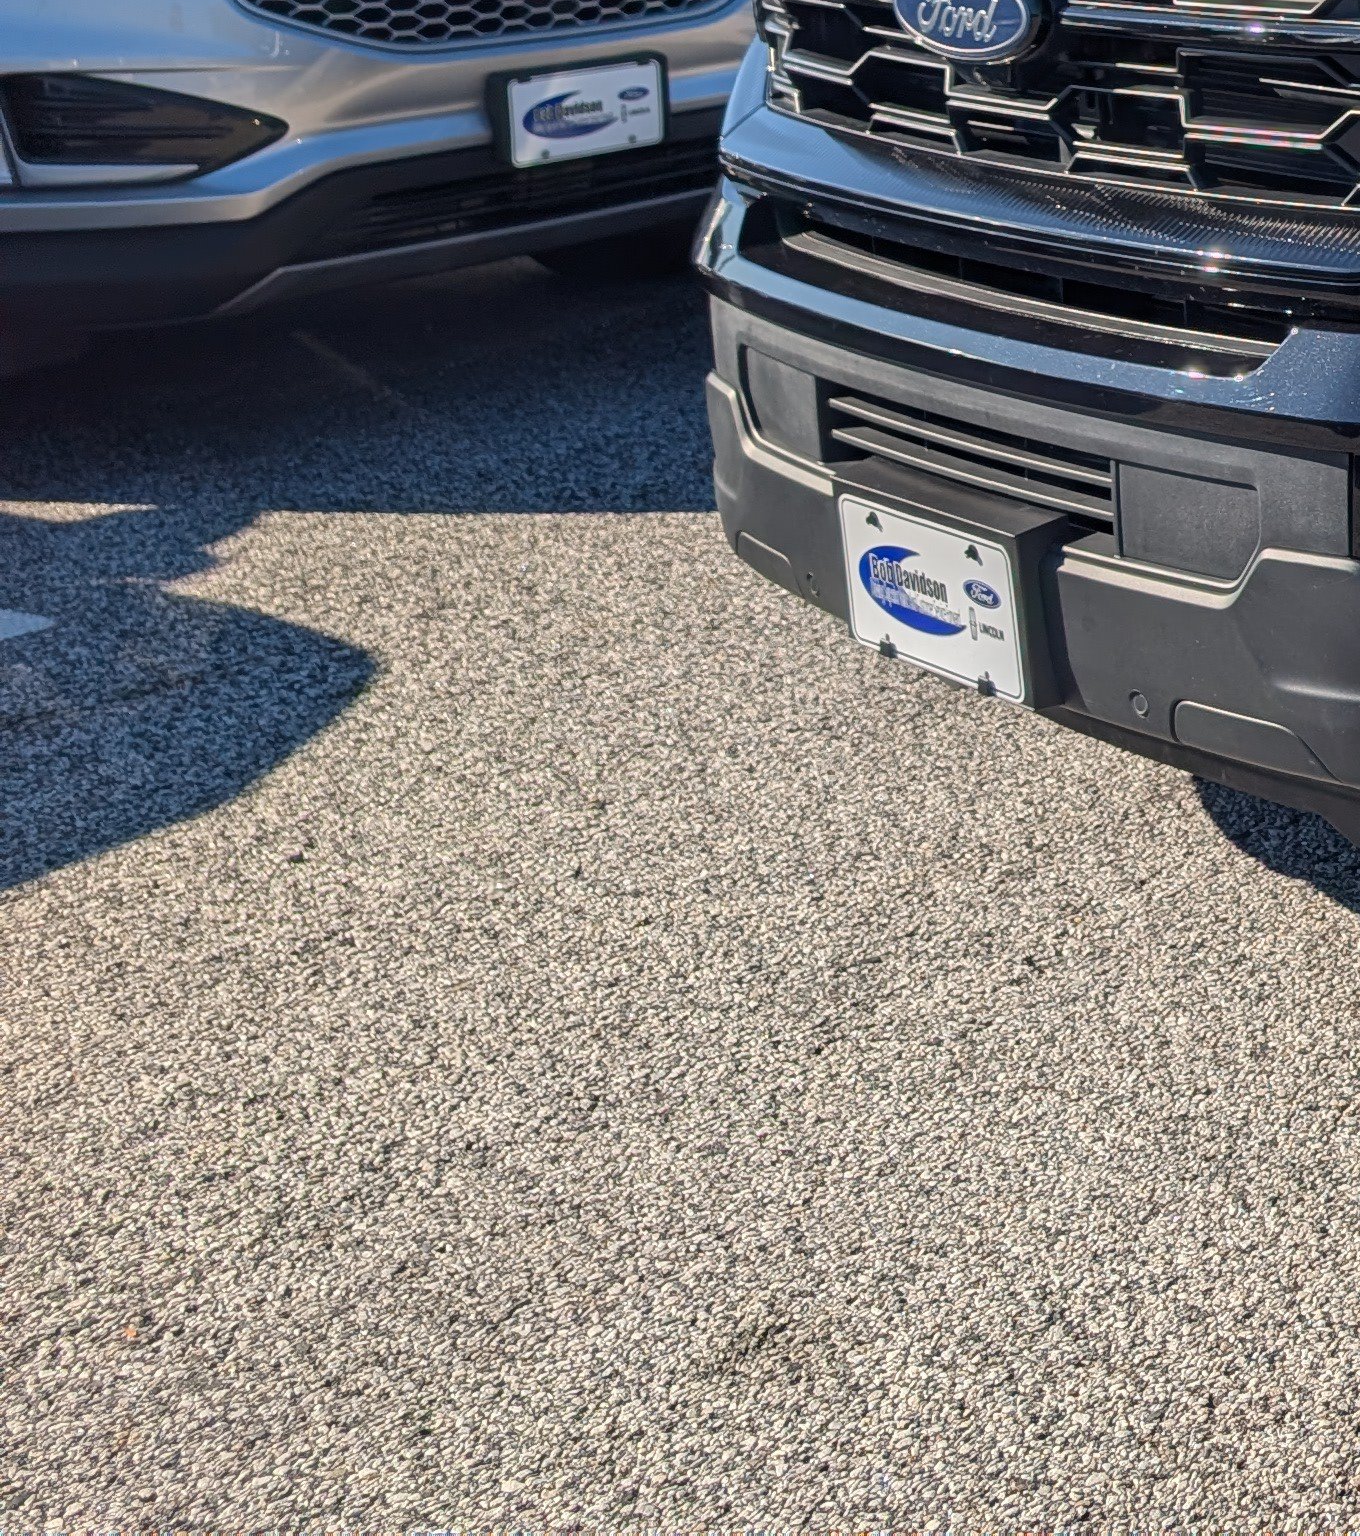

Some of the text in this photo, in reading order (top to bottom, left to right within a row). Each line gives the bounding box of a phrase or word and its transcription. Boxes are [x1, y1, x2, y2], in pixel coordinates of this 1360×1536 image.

[869, 553, 896, 585] Bob
[893, 561, 949, 604] Davidson
[969, 581, 996, 606] Ford
